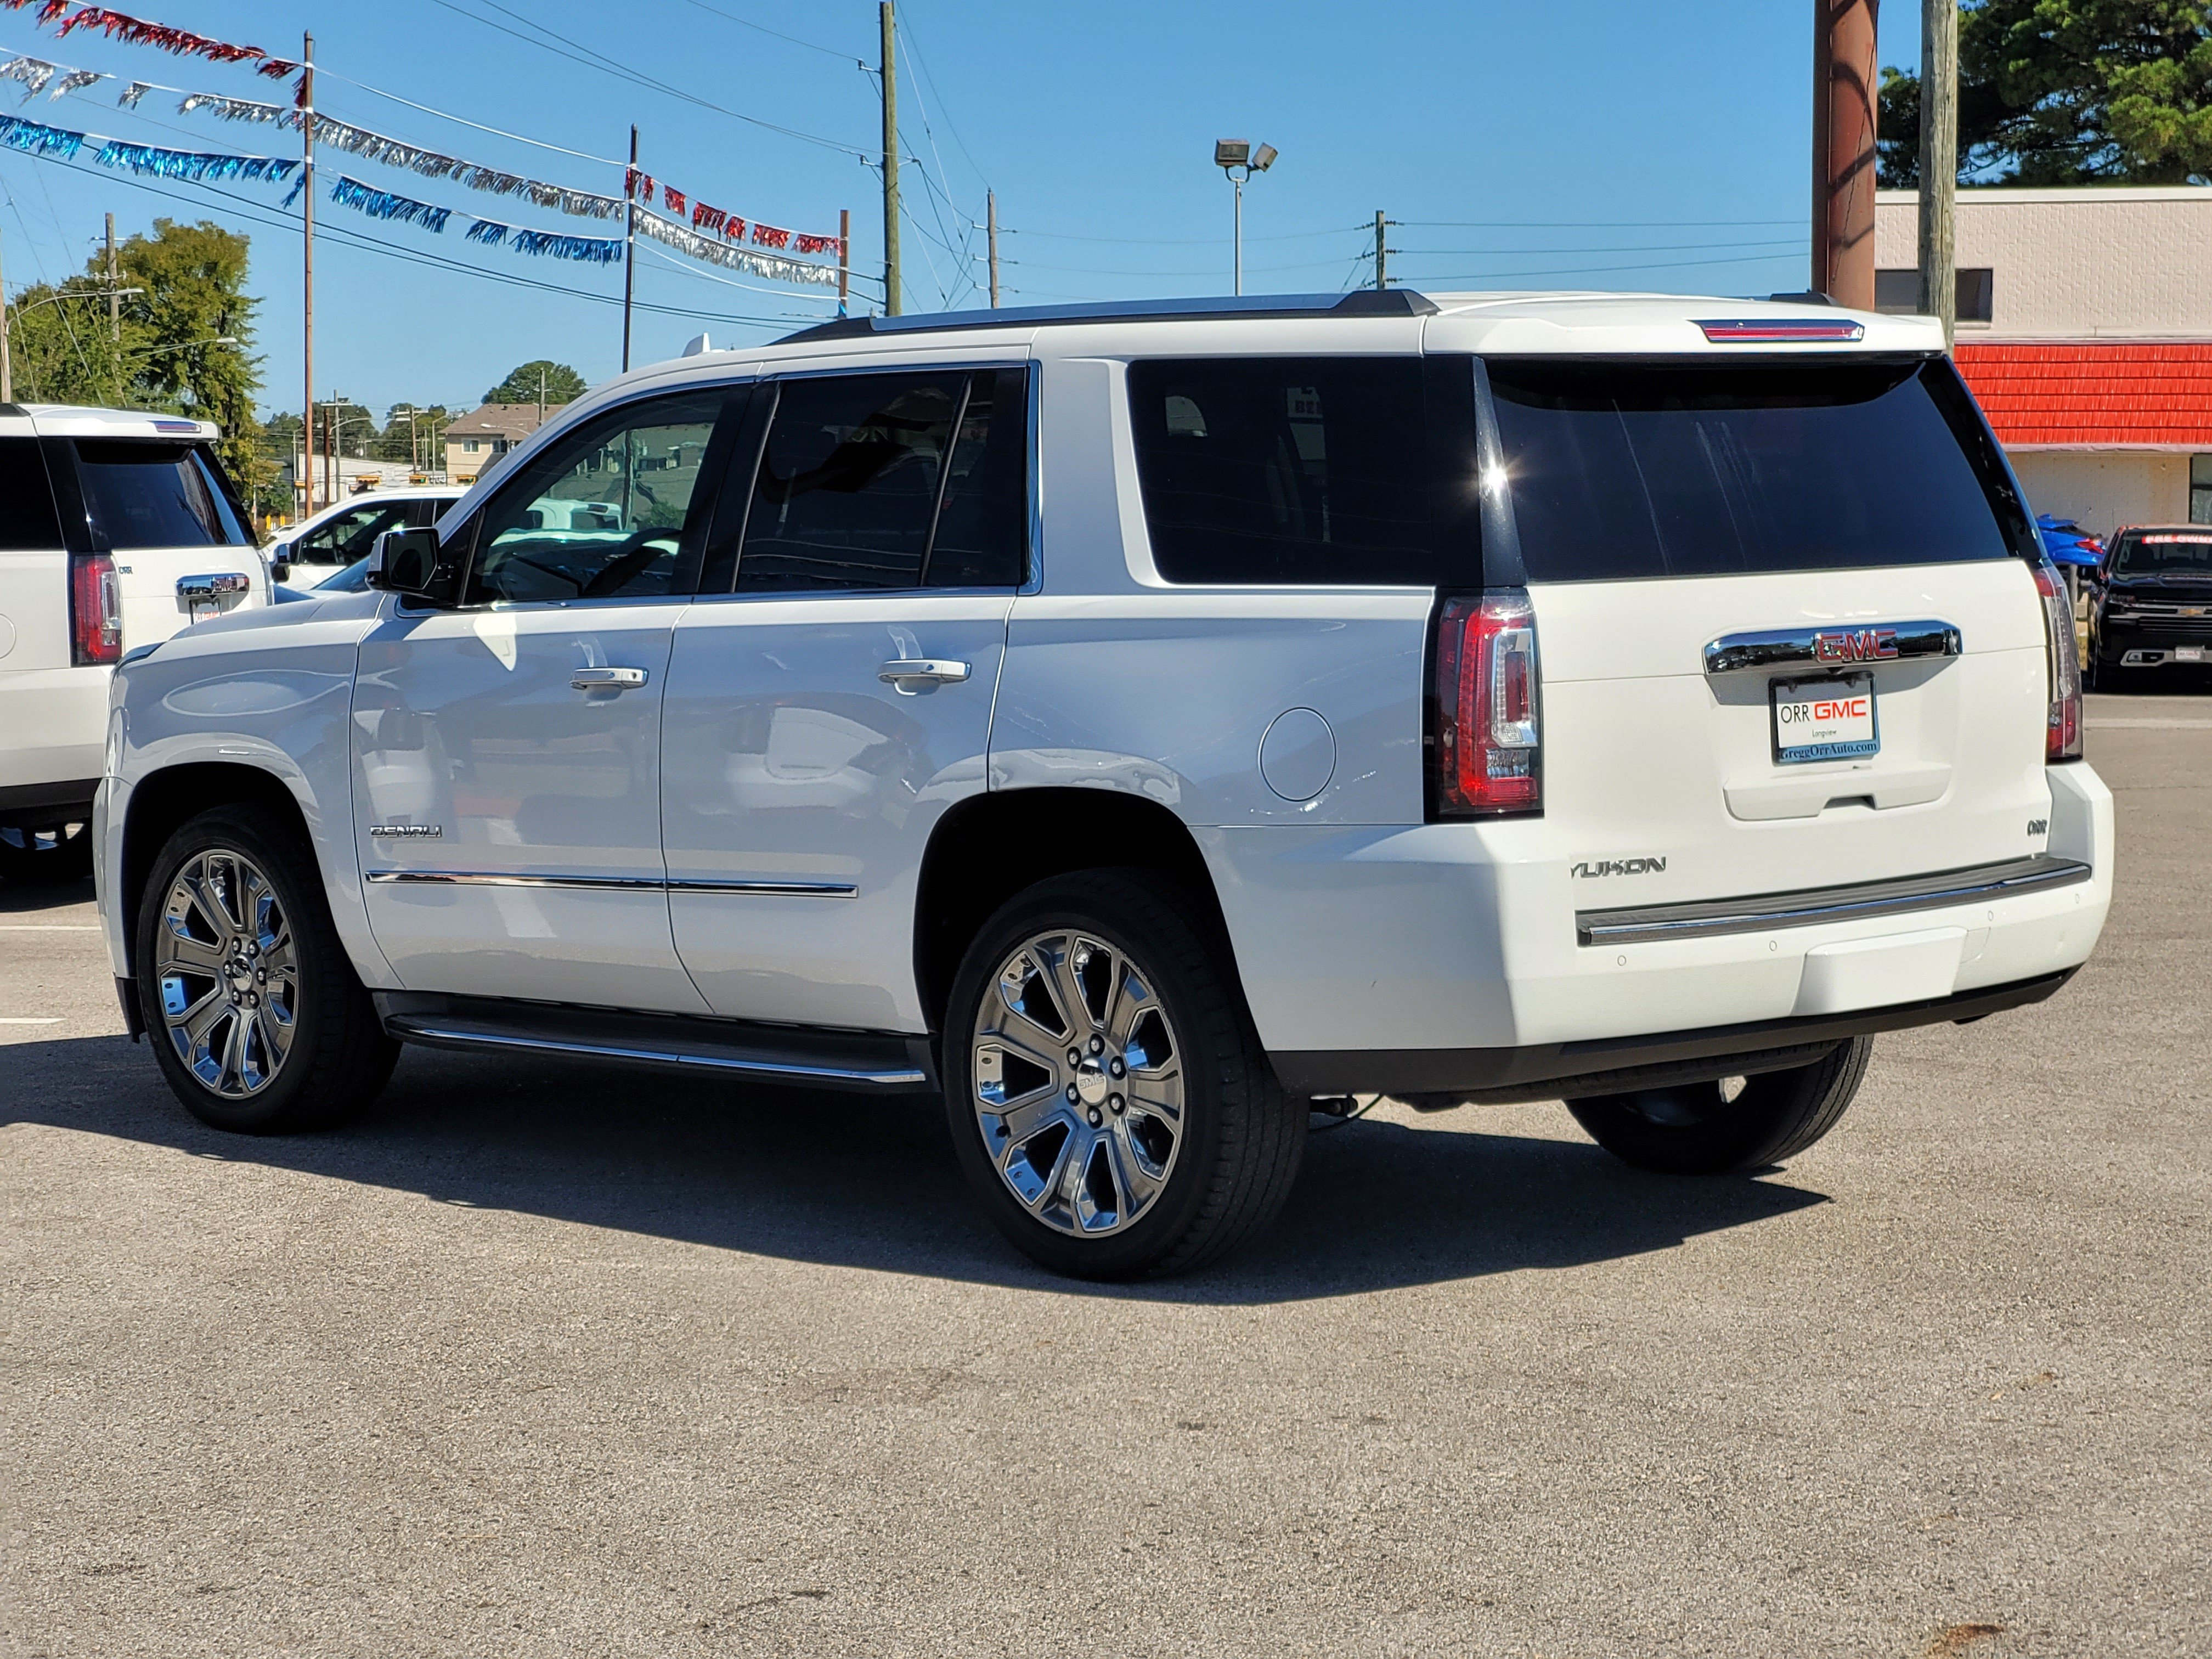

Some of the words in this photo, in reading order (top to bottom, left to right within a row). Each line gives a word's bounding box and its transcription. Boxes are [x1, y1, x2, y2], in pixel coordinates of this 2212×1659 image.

[1815, 629, 1898, 663] GMC
[1781, 704, 1810, 724] ORR
[1815, 700, 1866, 720] GMC
[1812, 729, 1837, 738] Longview
[1780, 742, 1877, 760] GreggOrrAuto.com
[370, 825, 442, 838] DENALI
[1571, 856, 1666, 879] YUKON
[1079, 1072, 1104, 1090] GMC
